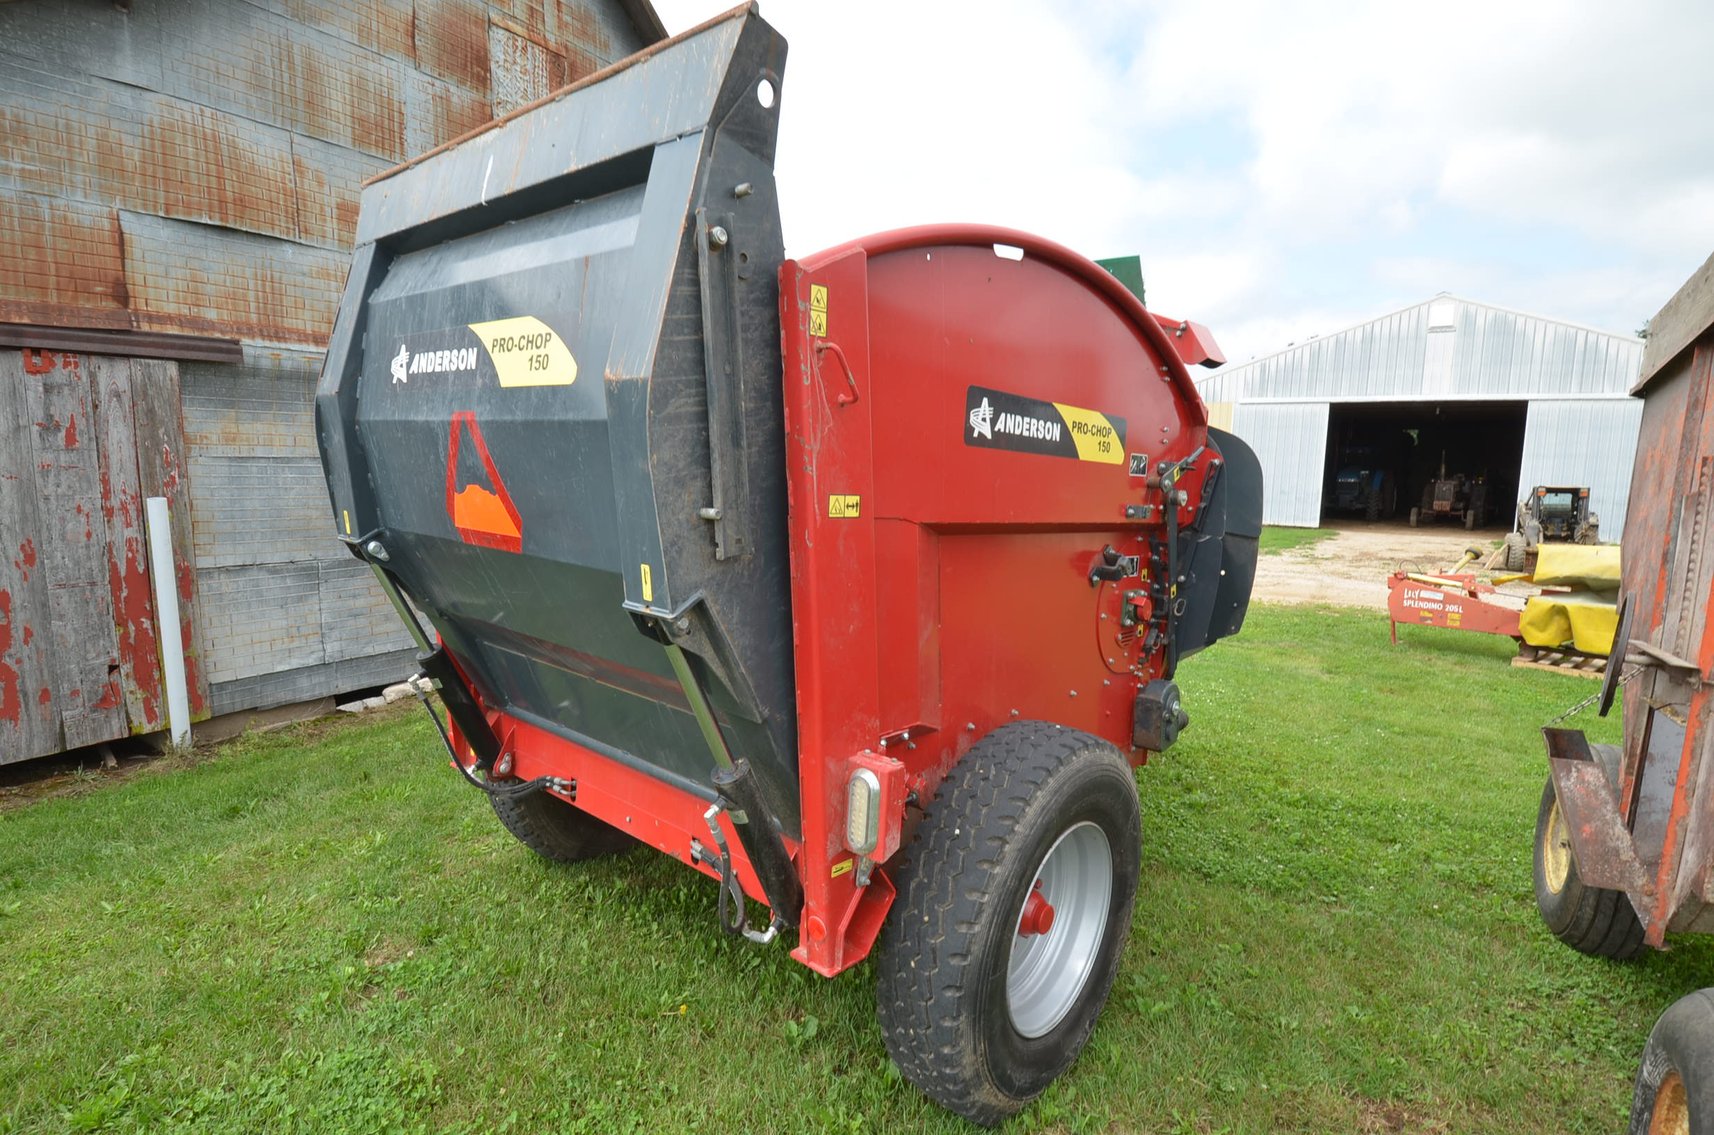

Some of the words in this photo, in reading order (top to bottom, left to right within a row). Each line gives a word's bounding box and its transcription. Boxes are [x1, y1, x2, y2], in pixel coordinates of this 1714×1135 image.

[491, 332, 552, 354] PRO-CHOP
[408, 347, 478, 375] ANDERSON
[527, 353, 550, 371] 150
[994, 412, 1061, 442] ANDERSON
[1071, 420, 1112, 439] PRO-CHOP
[1097, 440, 1111, 453] 150
[1403, 599, 1443, 610] SPLENDIMO
